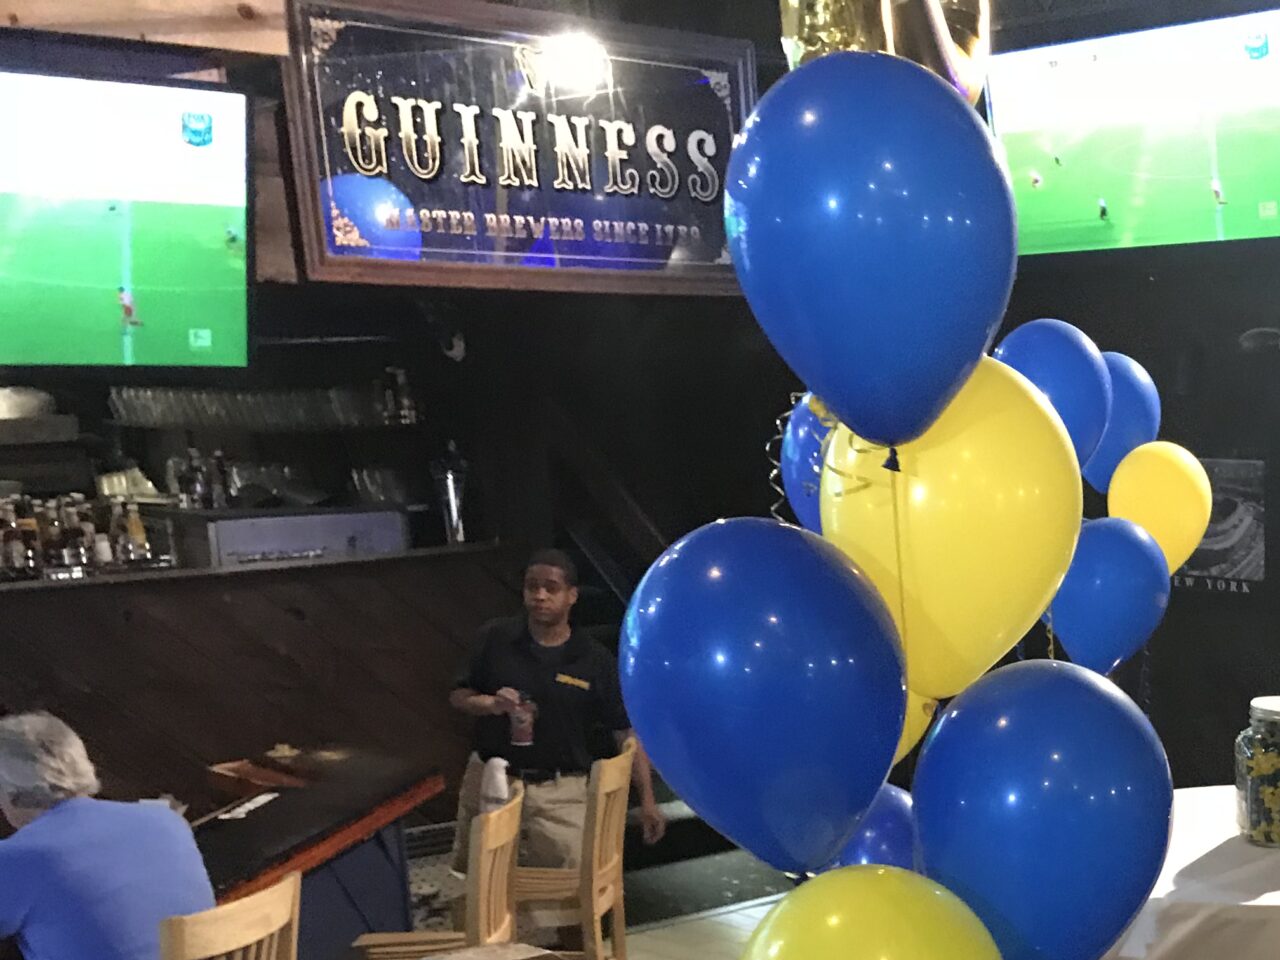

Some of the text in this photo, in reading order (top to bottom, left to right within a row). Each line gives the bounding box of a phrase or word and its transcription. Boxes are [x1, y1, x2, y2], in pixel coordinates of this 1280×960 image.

[342, 90, 720, 202] GUINNESS
[384, 207, 477, 236] MASTER
[484, 212, 586, 240] BREWERS
[592, 218, 649, 245] SINCE
[1174, 574, 1250, 593] EW YORK
